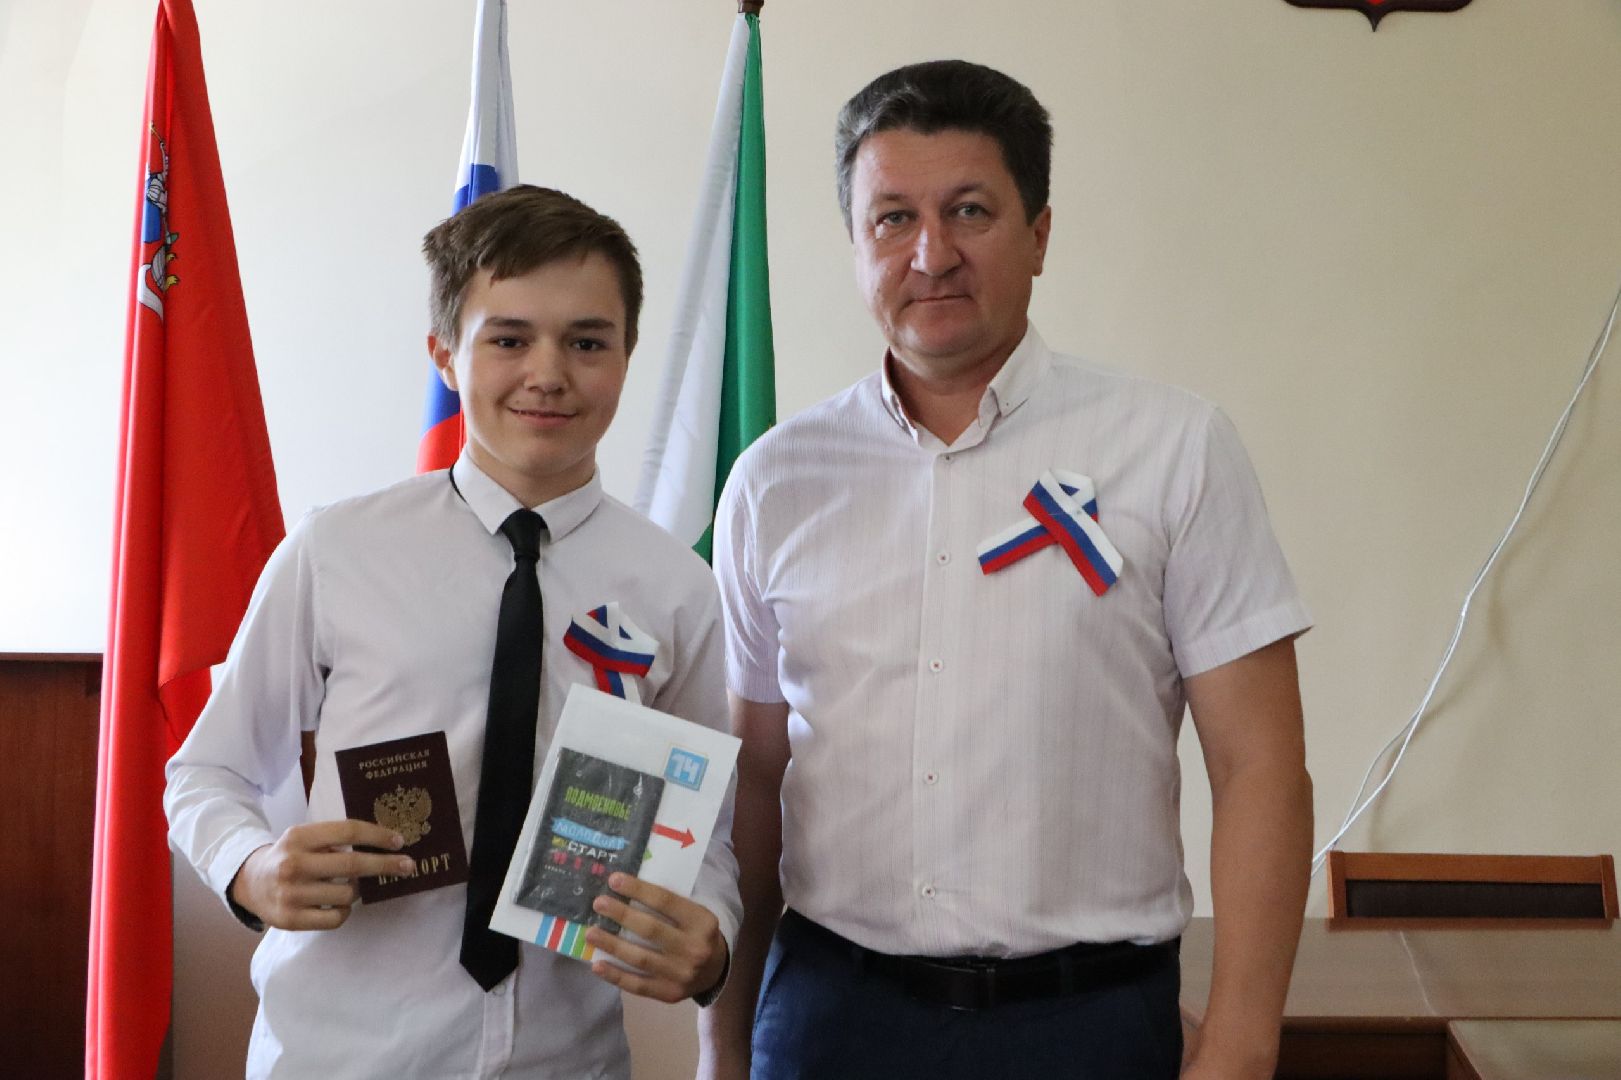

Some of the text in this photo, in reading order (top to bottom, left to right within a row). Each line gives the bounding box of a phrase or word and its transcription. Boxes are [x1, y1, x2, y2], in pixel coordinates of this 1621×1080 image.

[359, 749, 430, 770] РОССИЙСКАЯ
[671, 753, 701, 785] 14
[365, 761, 427, 780] ФЕДЕРАЦИЯ
[565, 785, 632, 820] ПОДМОСКОВЬЕ
[568, 841, 618, 862] СТАРТ
